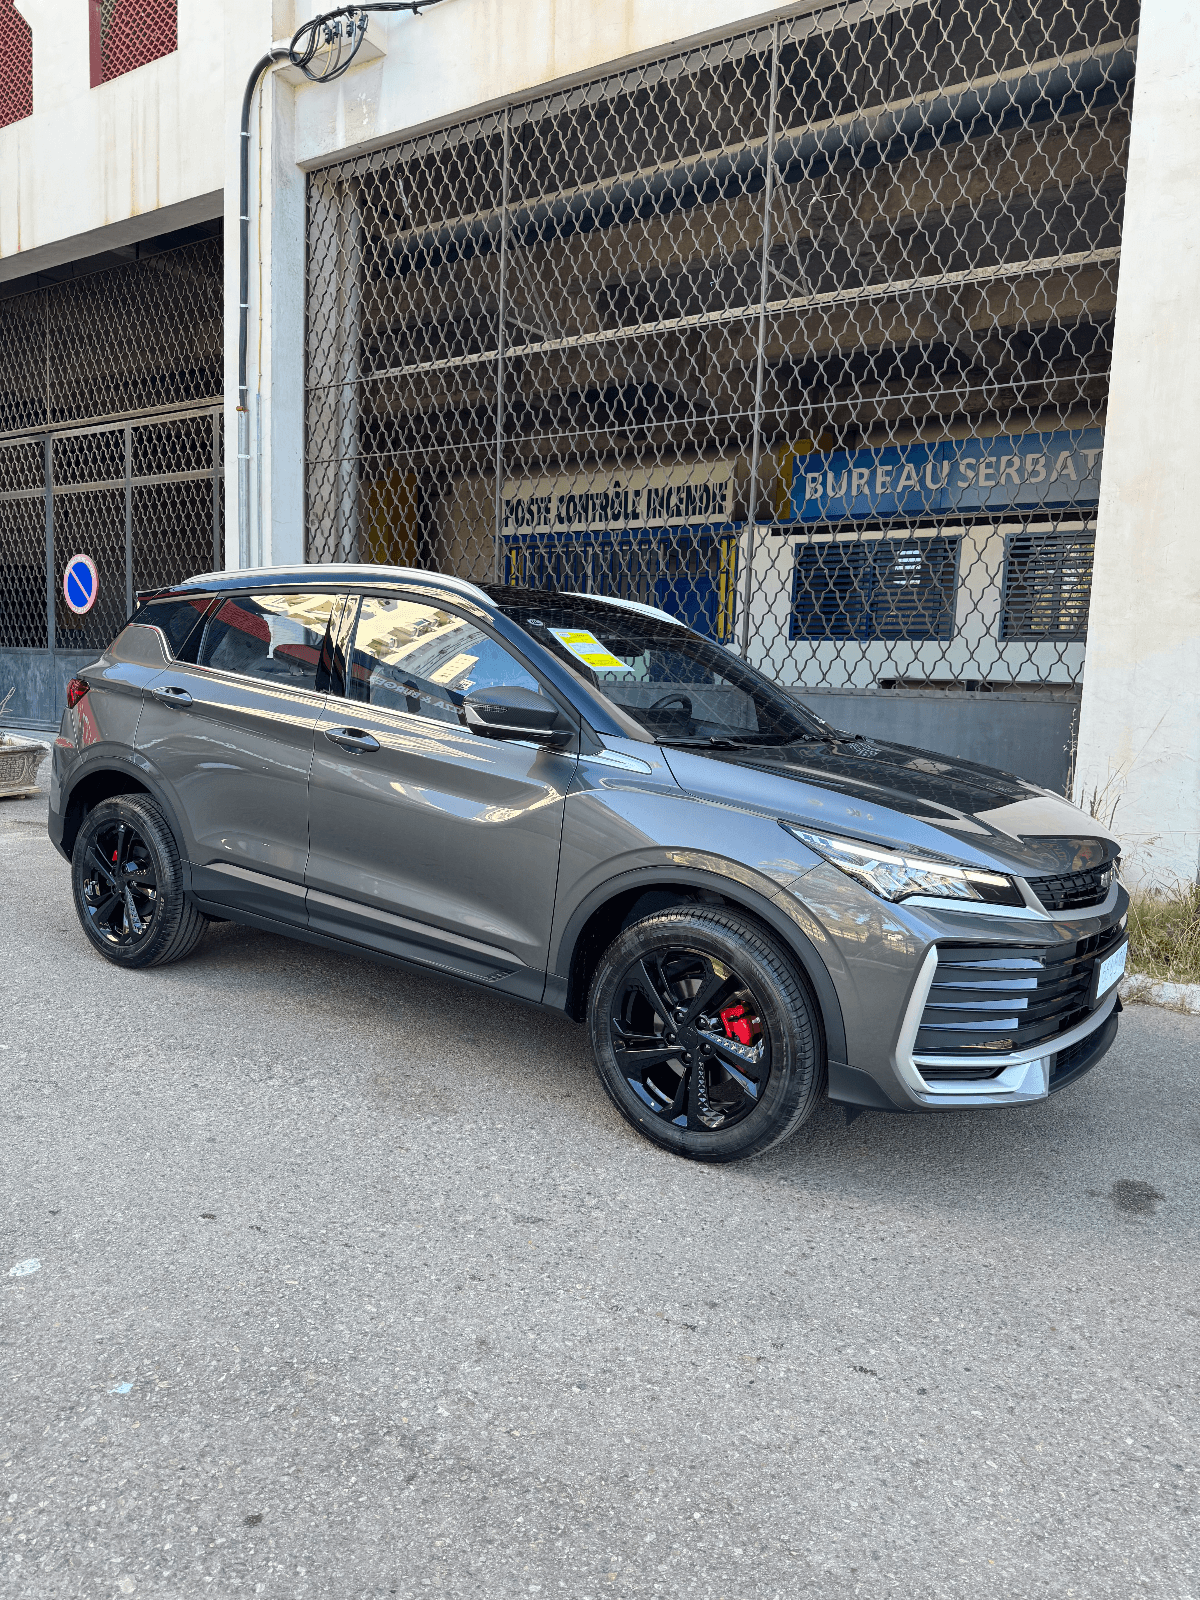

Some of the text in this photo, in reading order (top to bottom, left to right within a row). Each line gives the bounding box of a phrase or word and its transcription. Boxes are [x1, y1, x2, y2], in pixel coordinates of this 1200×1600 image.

[805, 448, 1103, 500] BUREAU SERBAT
[504, 480, 728, 528] POSTE CONTRÔLE INCENDIE
